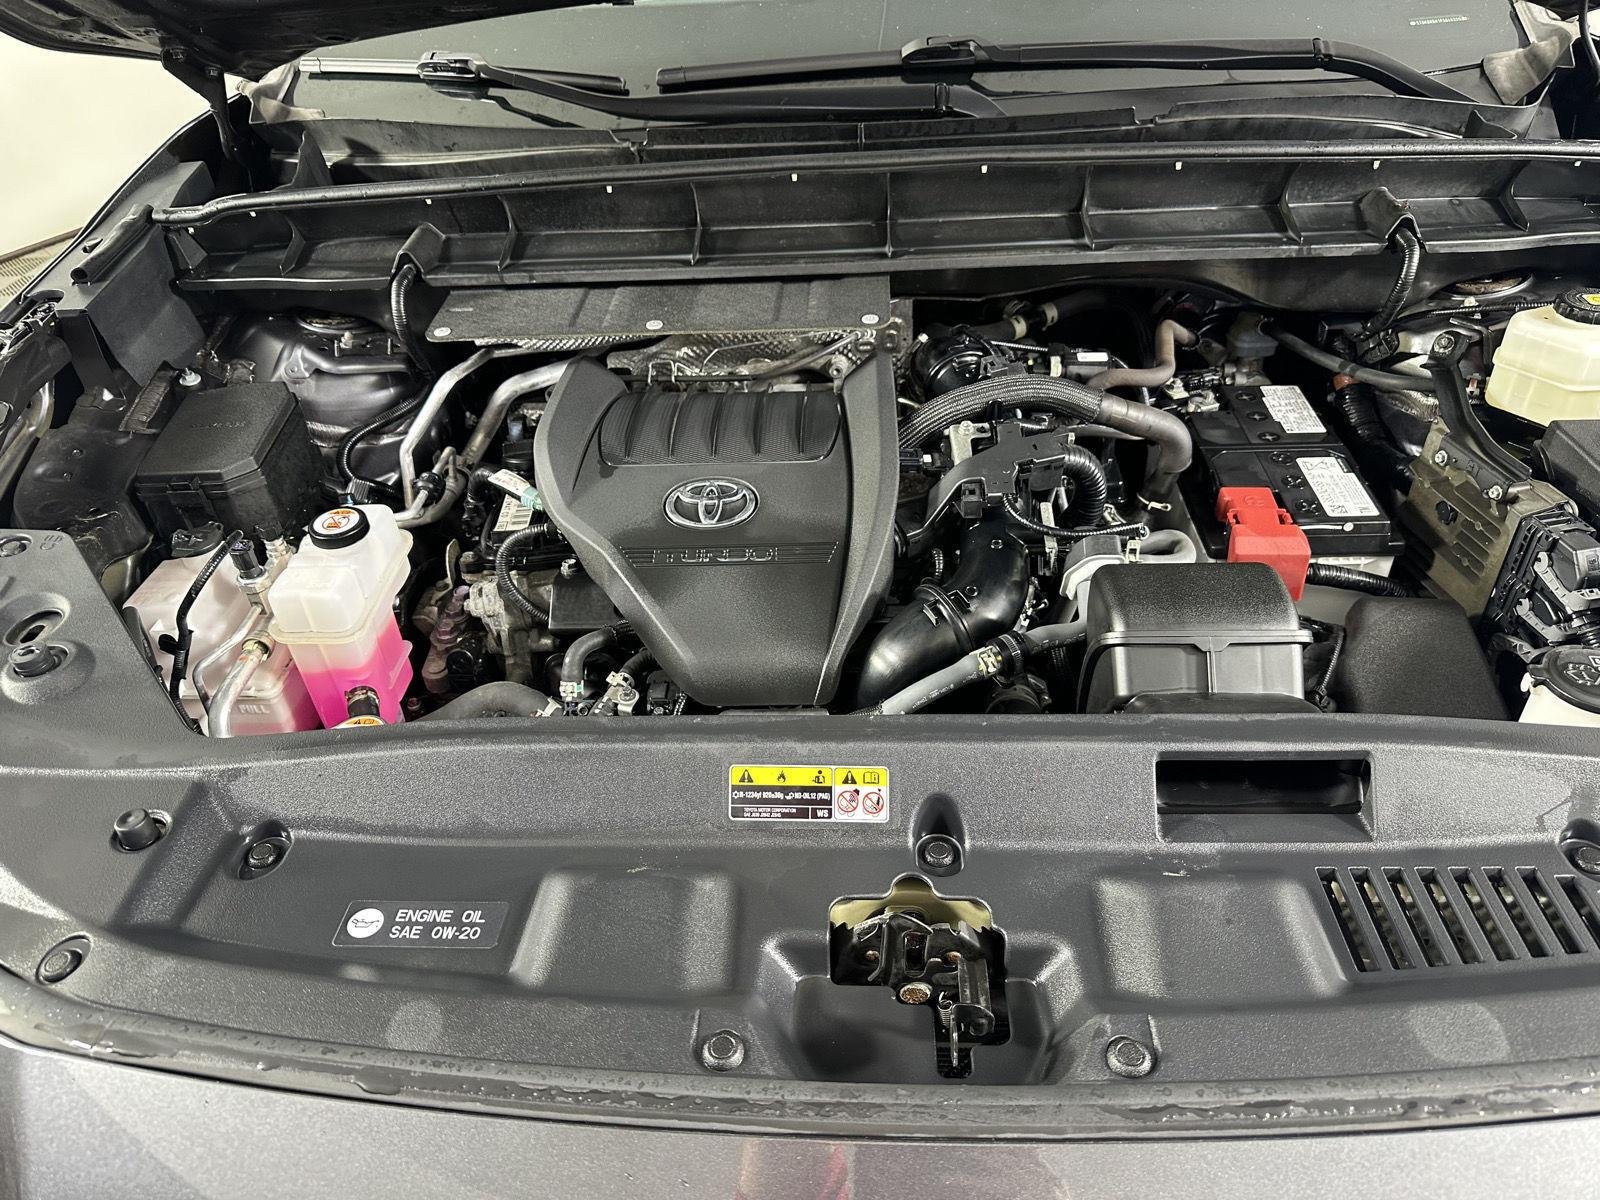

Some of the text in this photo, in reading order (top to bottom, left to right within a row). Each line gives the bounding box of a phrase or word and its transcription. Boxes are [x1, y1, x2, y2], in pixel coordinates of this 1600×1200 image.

[816, 809, 829, 818] WS
[395, 909, 486, 923] ENGINE OIL
[389, 925, 423, 939] SAE
